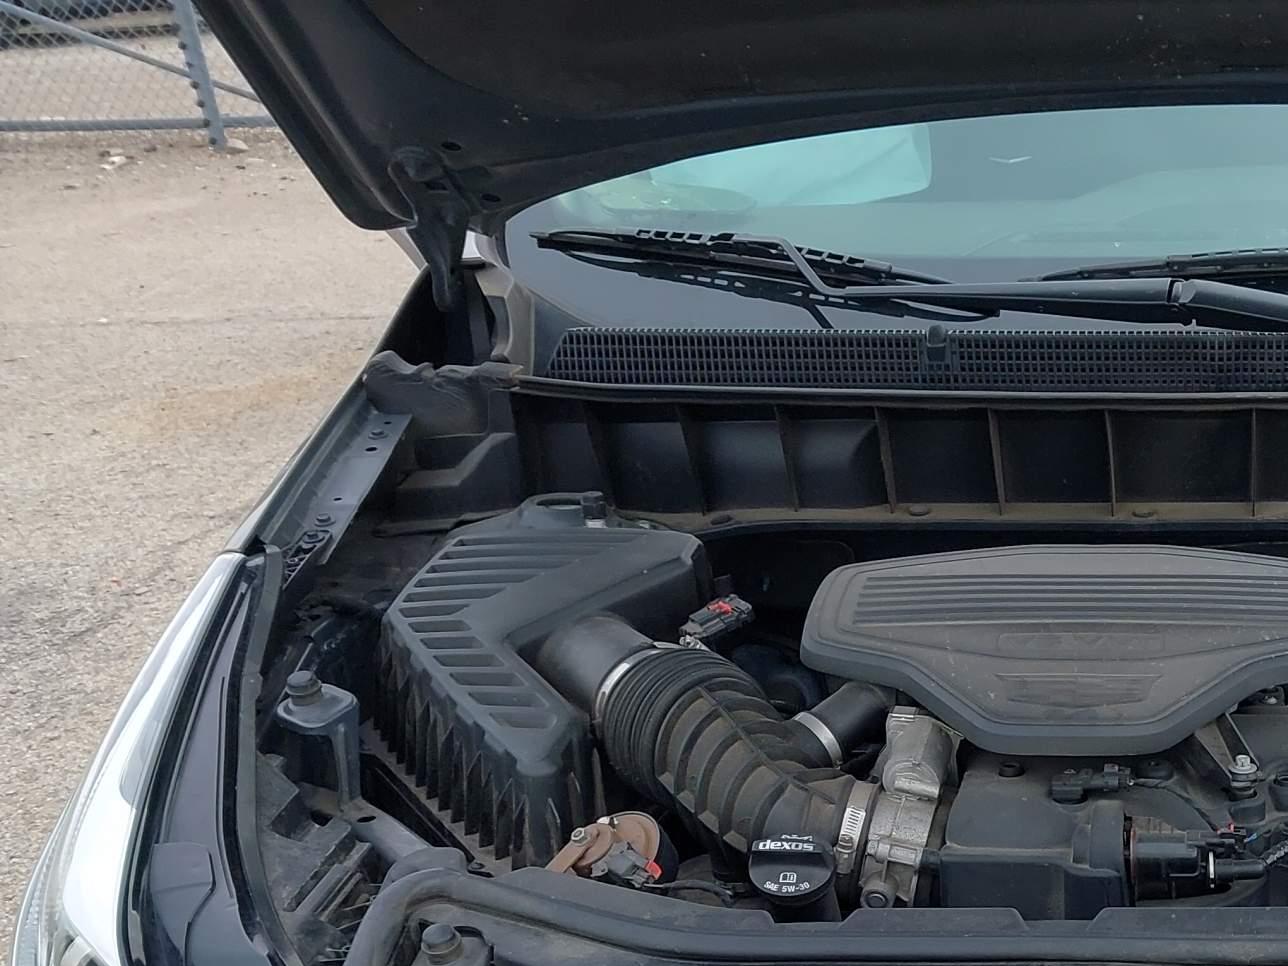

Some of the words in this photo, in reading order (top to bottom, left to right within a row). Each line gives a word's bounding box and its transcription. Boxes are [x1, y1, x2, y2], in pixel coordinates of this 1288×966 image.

[758, 839, 817, 851] dexos
[763, 881, 781, 892] SAE
[781, 881, 810, 893] 5W-30
